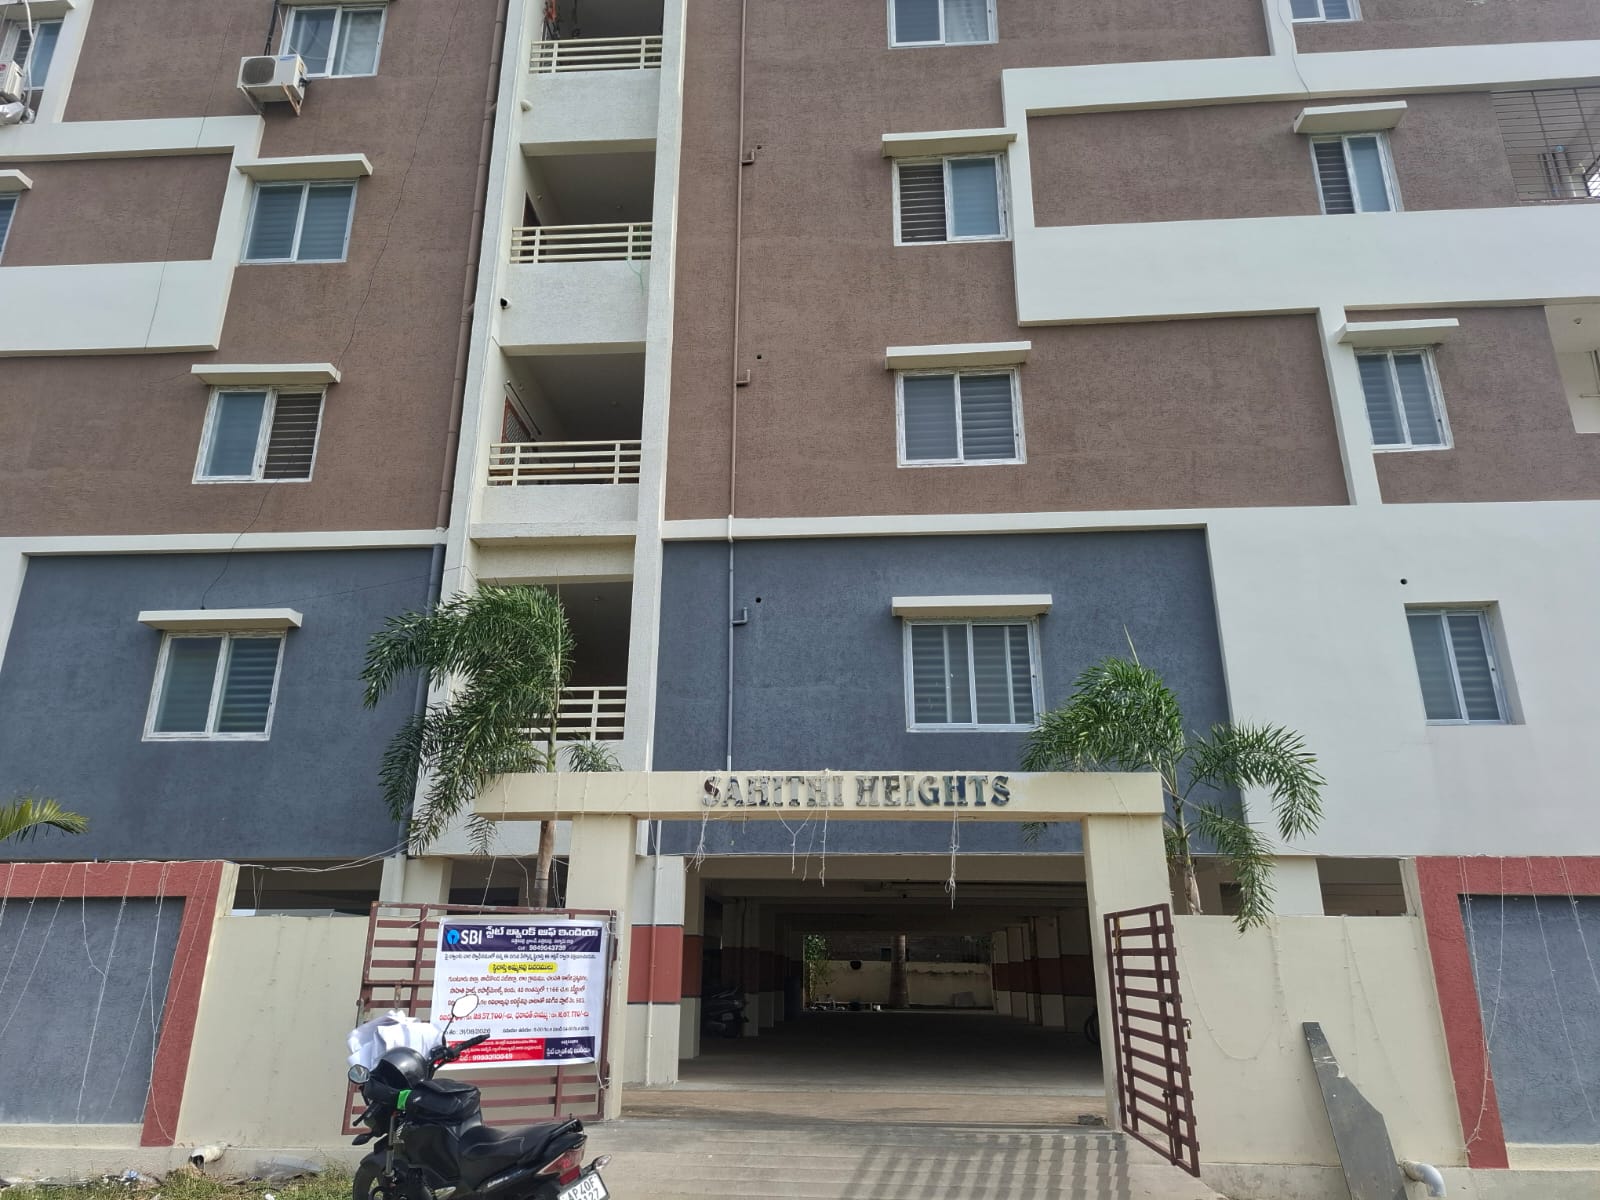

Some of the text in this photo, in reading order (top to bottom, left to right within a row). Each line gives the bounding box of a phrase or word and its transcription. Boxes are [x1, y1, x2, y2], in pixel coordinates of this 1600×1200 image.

[702, 775, 1011, 807] SAHITHI HEIGHTS
[460, 929, 482, 945] SBI
